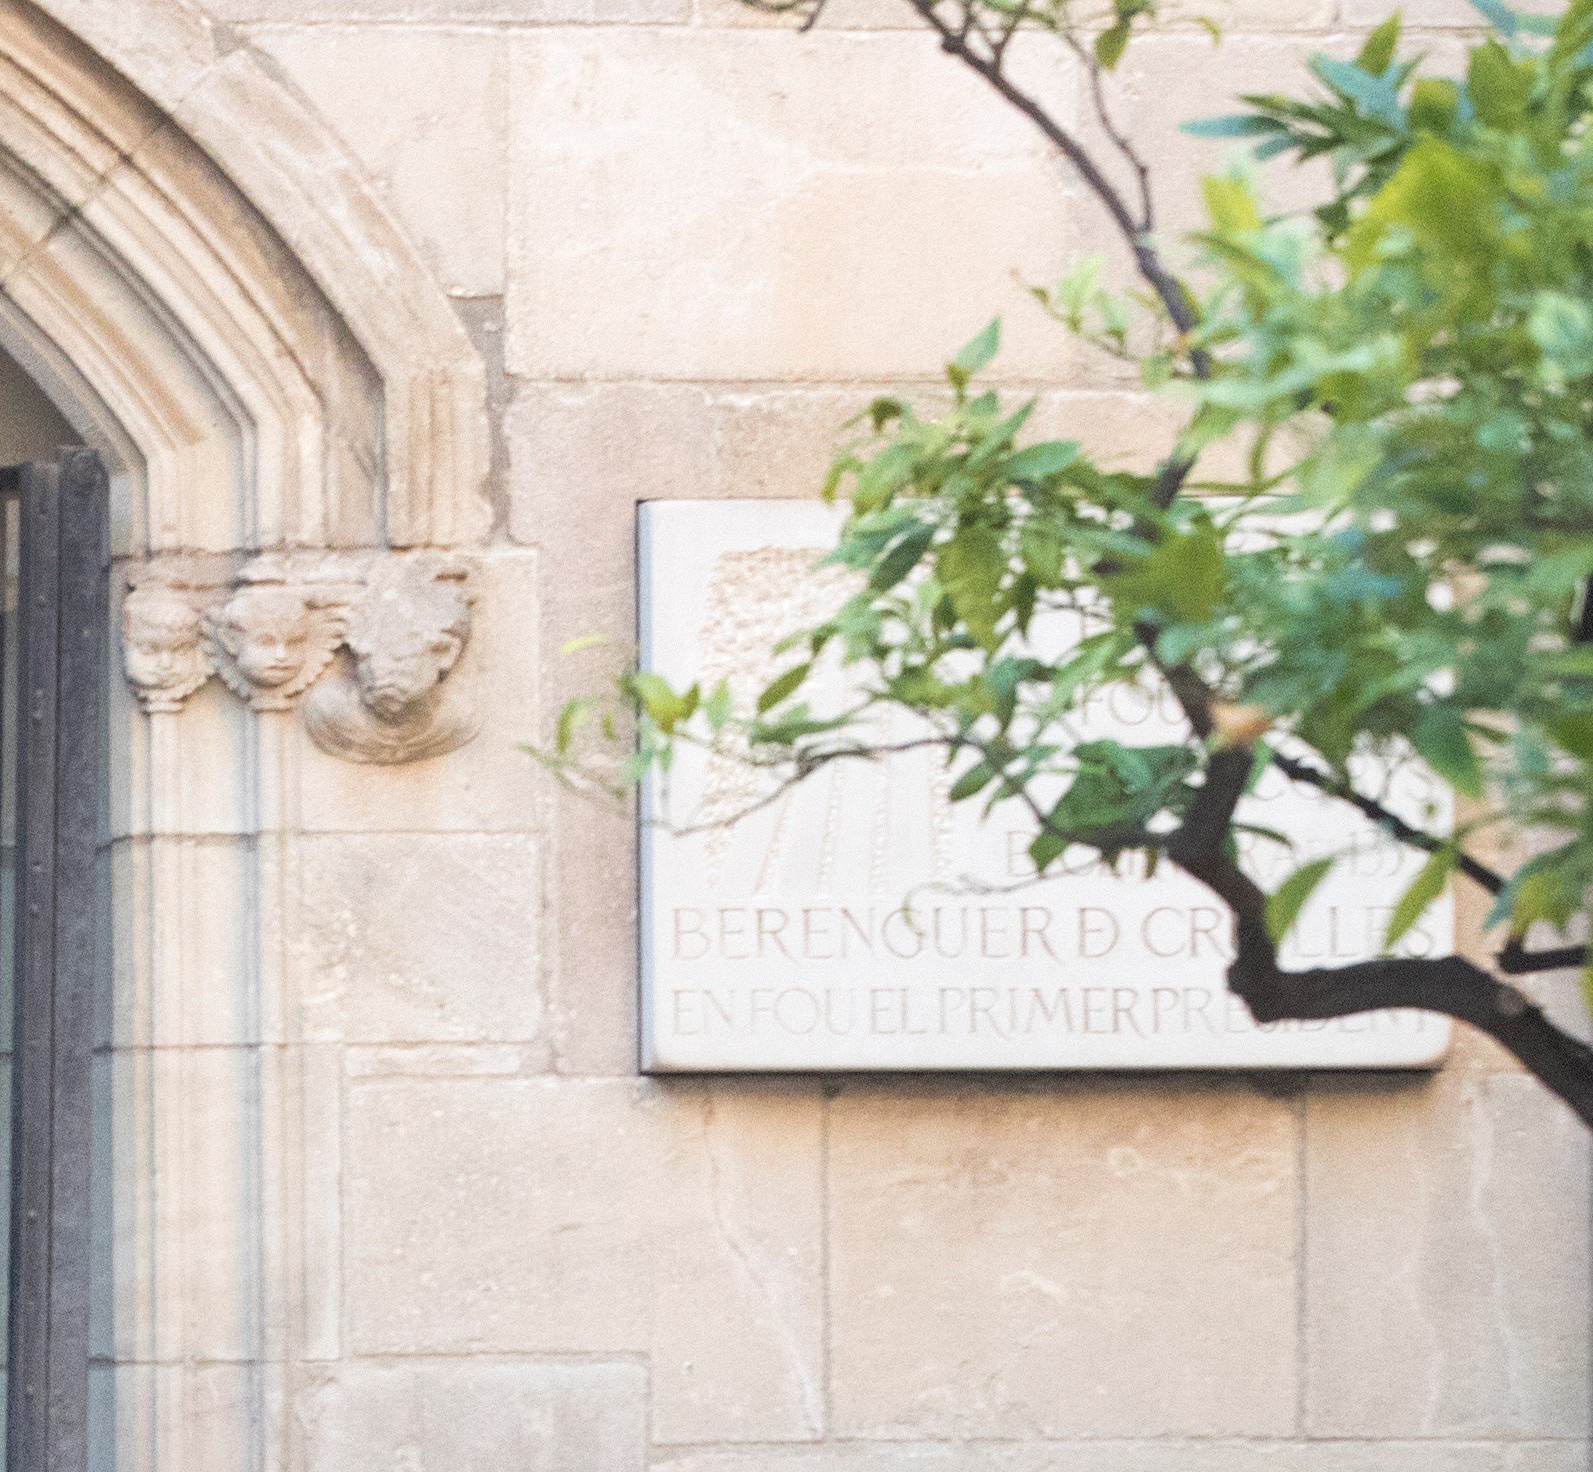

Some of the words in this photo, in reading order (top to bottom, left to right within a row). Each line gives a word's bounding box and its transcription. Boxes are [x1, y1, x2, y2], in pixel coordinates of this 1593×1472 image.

[671, 905, 1061, 960] BERENGUER
[1141, 905, 1435, 958] CRLLES
[671, 987, 735, 1035] EN
[749, 986, 856, 1035] FOU
[869, 987, 926, 1034] EL
[939, 986, 1147, 1039] PRIMER
